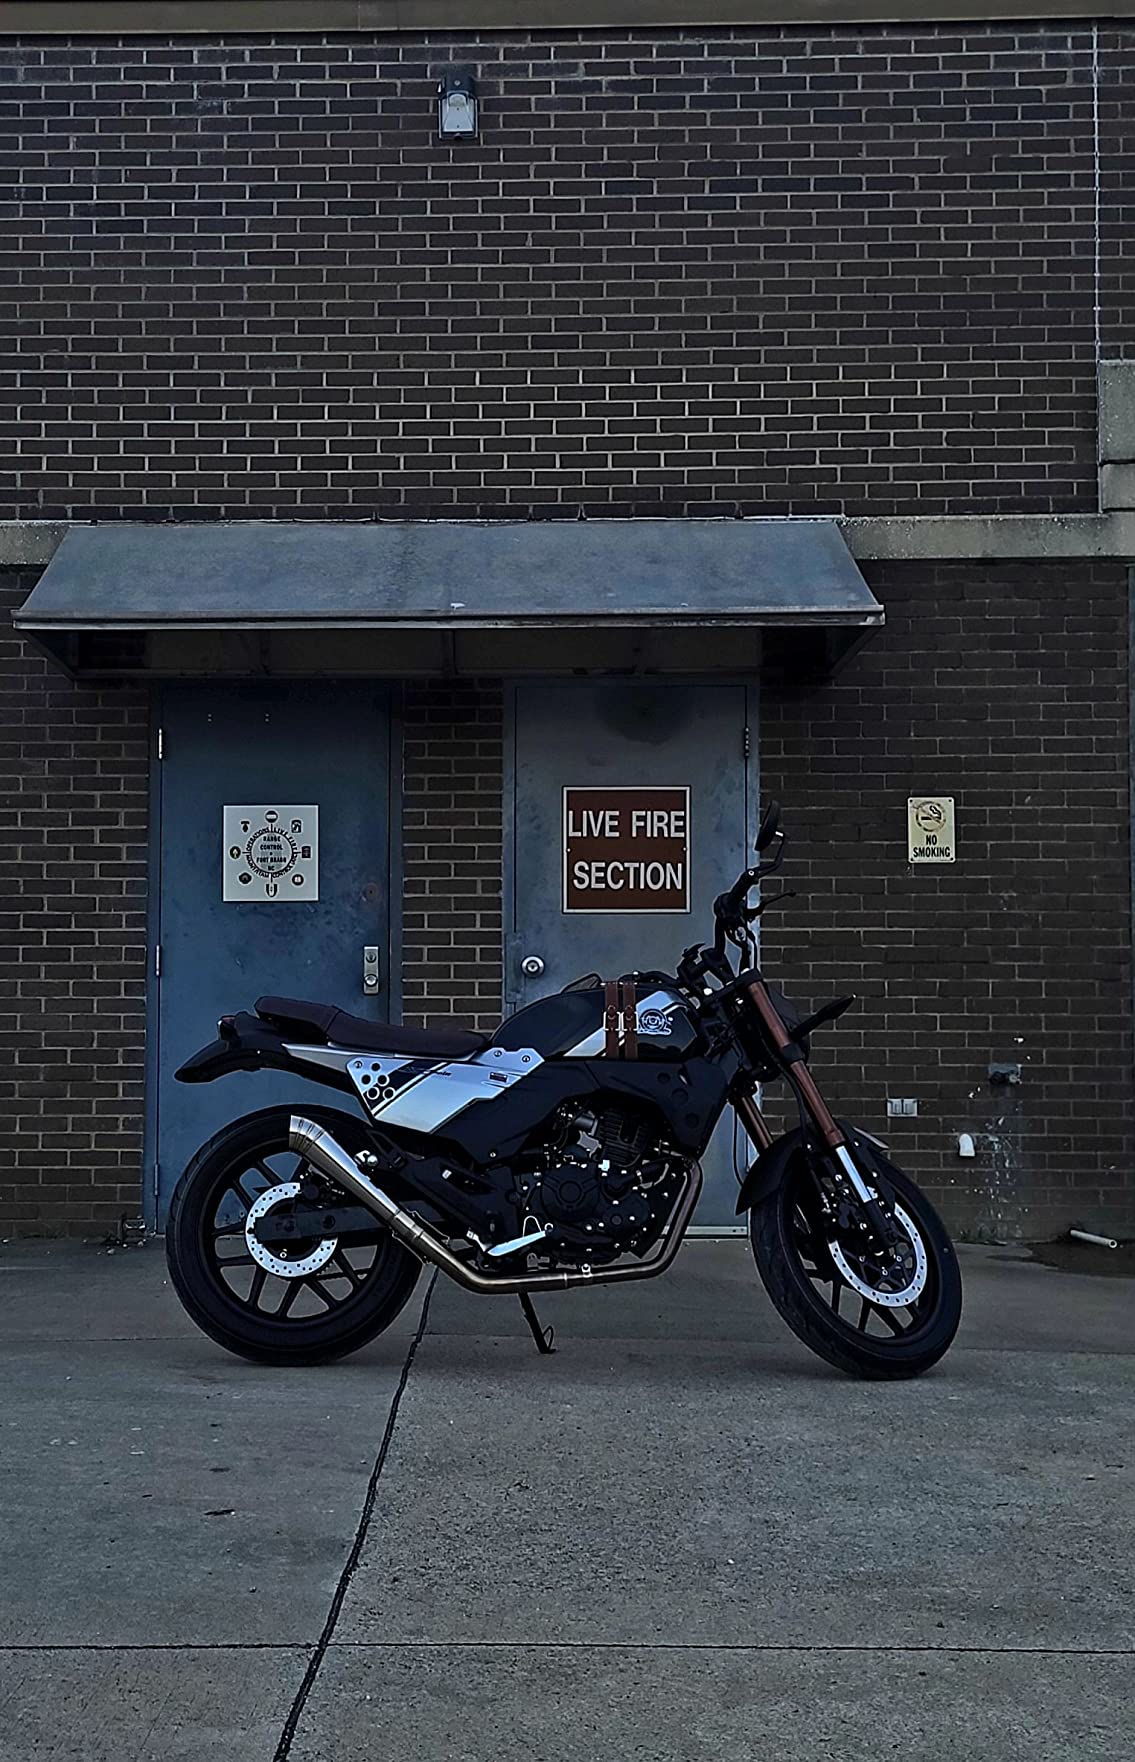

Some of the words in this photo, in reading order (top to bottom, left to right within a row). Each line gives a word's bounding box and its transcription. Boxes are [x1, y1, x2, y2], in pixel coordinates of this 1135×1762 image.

[568, 810, 620, 838] LIVE
[631, 810, 685, 838] FIRE
[926, 834, 938, 846] NO
[913, 846, 951, 858] SMOKING
[573, 860, 683, 890] SECTION
